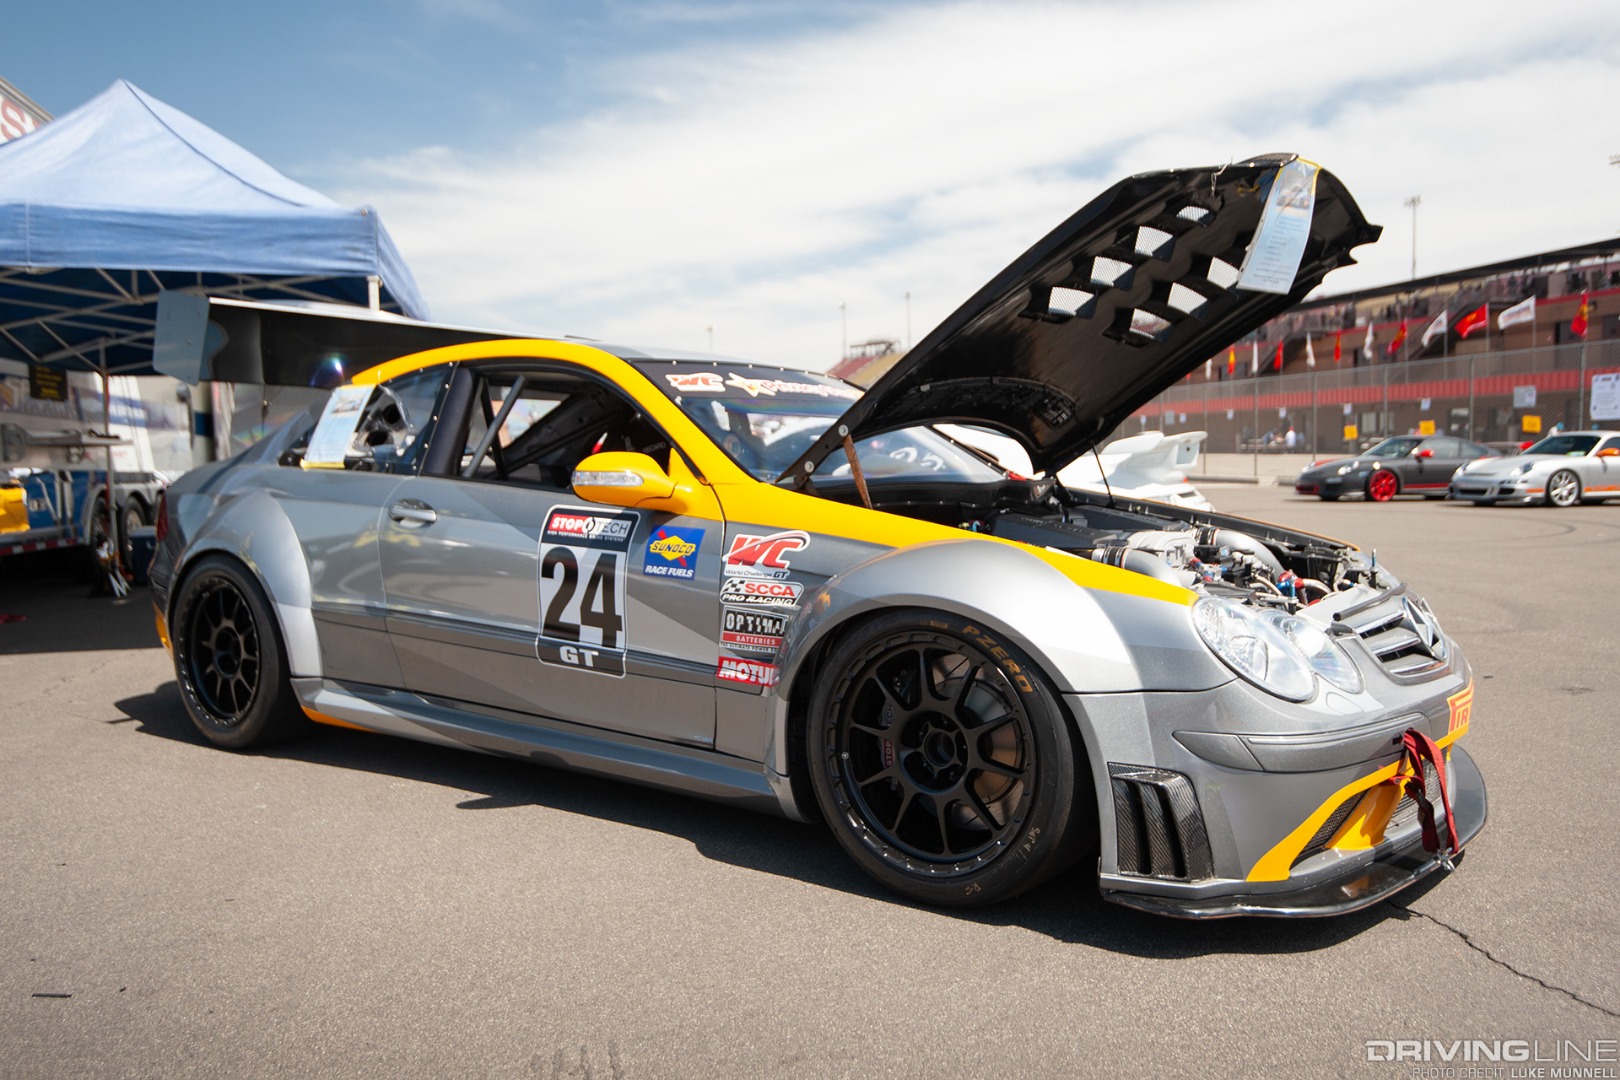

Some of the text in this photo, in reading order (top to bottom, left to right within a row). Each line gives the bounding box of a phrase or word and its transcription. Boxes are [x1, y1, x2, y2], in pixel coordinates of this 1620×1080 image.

[652, 542, 693, 554] SUNOCO
[645, 565, 694, 578] RACE FUELS
[773, 570, 788, 578] GT
[745, 582, 795, 597] SCCA
[541, 546, 622, 648] 24
[722, 594, 794, 606] PRO RACING
[736, 635, 776, 645] BATTERIES
[560, 646, 599, 667] GT
